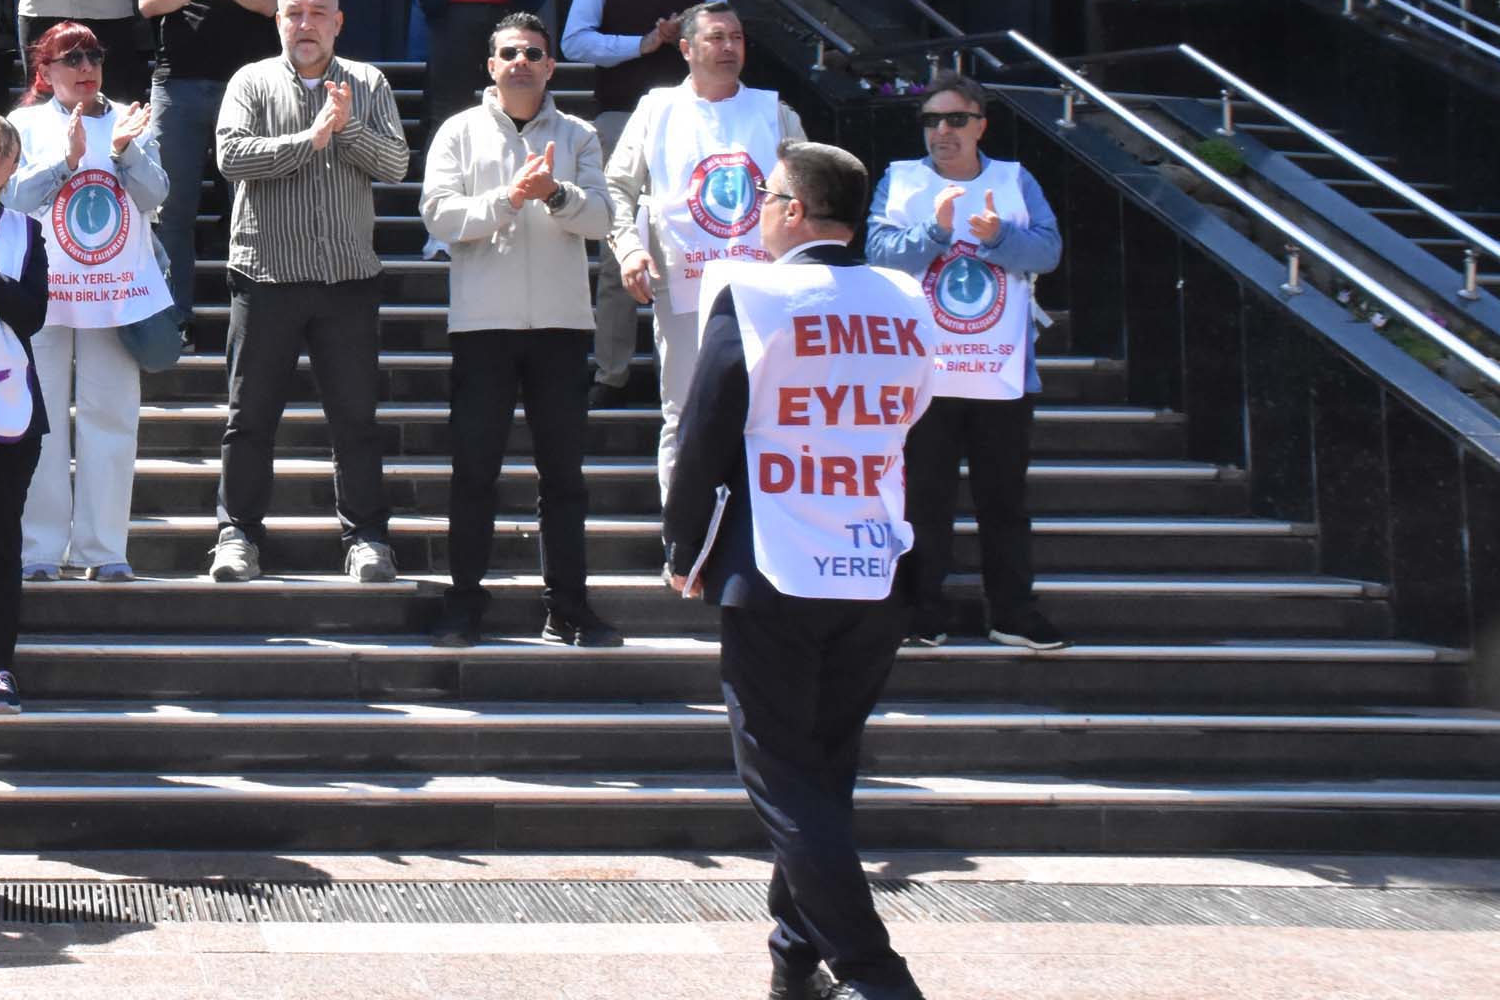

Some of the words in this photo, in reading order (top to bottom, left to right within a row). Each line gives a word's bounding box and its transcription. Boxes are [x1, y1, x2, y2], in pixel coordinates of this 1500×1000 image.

[83, 272, 135, 284] YEREL-SEN
[48, 290, 73, 301] MAN
[76, 289, 110, 302] BİRLİK
[112, 286, 150, 300] ZAMANI
[793, 314, 927, 357] EMEK
[814, 556, 890, 578] YEREL
